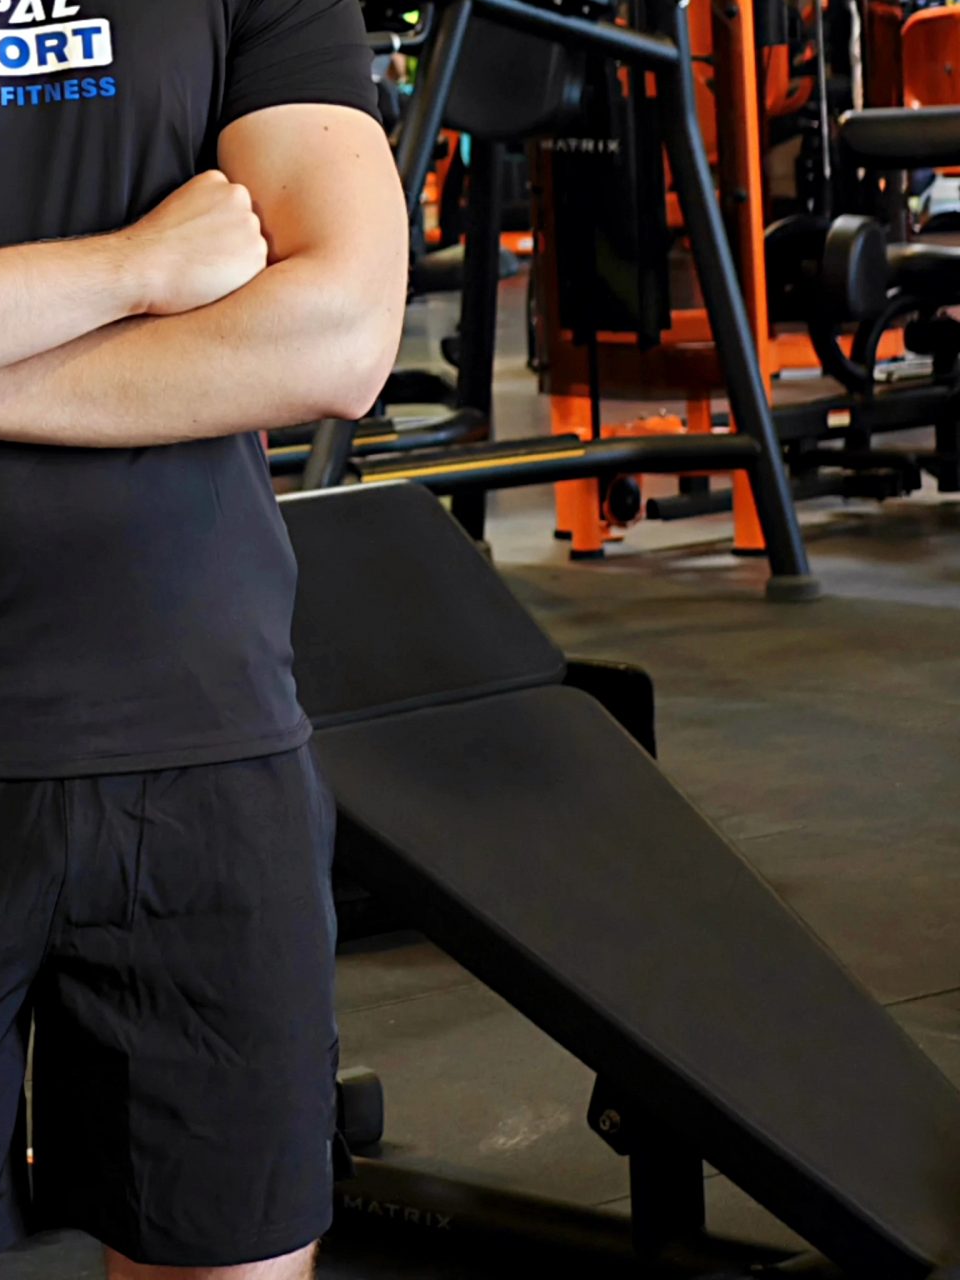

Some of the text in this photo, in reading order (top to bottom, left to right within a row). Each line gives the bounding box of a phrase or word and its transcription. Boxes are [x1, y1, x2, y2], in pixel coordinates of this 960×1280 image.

[0, 76, 116, 106] FITNESS
[541, 137, 619, 153] MATRIX
[343, 1195, 451, 1230] MATRIX
